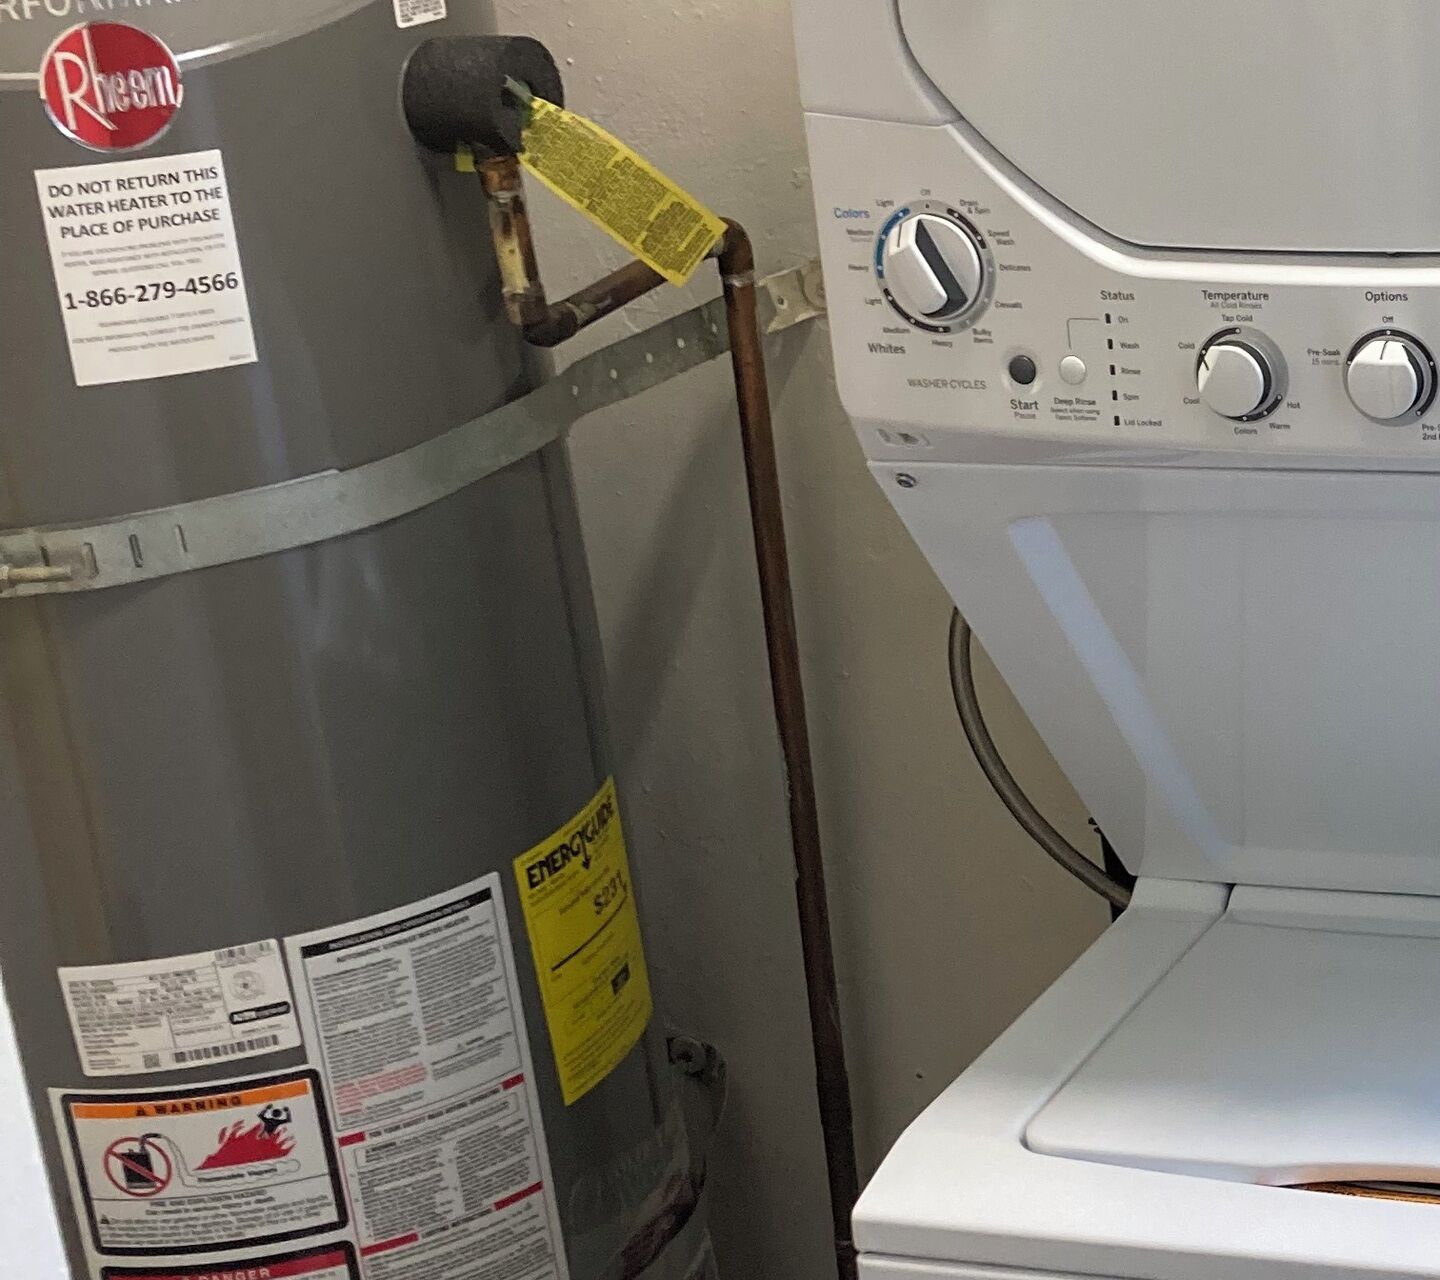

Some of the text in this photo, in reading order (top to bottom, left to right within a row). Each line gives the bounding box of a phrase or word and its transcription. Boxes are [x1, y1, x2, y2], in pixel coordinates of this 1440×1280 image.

[53, 28, 177, 131] Rheem
[48, 167, 218, 198] DO NOT RETURN THIS
[47, 186, 223, 219] WATER HEATER TO THE
[834, 207, 870, 219] Colors
[60, 208, 221, 239] PLACE OF PURCHASE
[64, 271, 239, 310] 1-866-279-4566
[1100, 290, 1135, 301] Status
[1201, 290, 1270, 302] Temperature
[1365, 291, 1408, 303] Options
[1222, 314, 1253, 322] Tap Cold
[868, 342, 906, 354] Whites
[1178, 342, 1195, 350] Cold
[907, 379, 987, 390] WASHER CYCLES
[1010, 399, 1039, 411] Start
[1234, 427, 1258, 435] Colors
[1269, 422, 1291, 430] Warm
[1422, 433, 1437, 441] 2nd
[155, 1095, 243, 1115] WARNING
